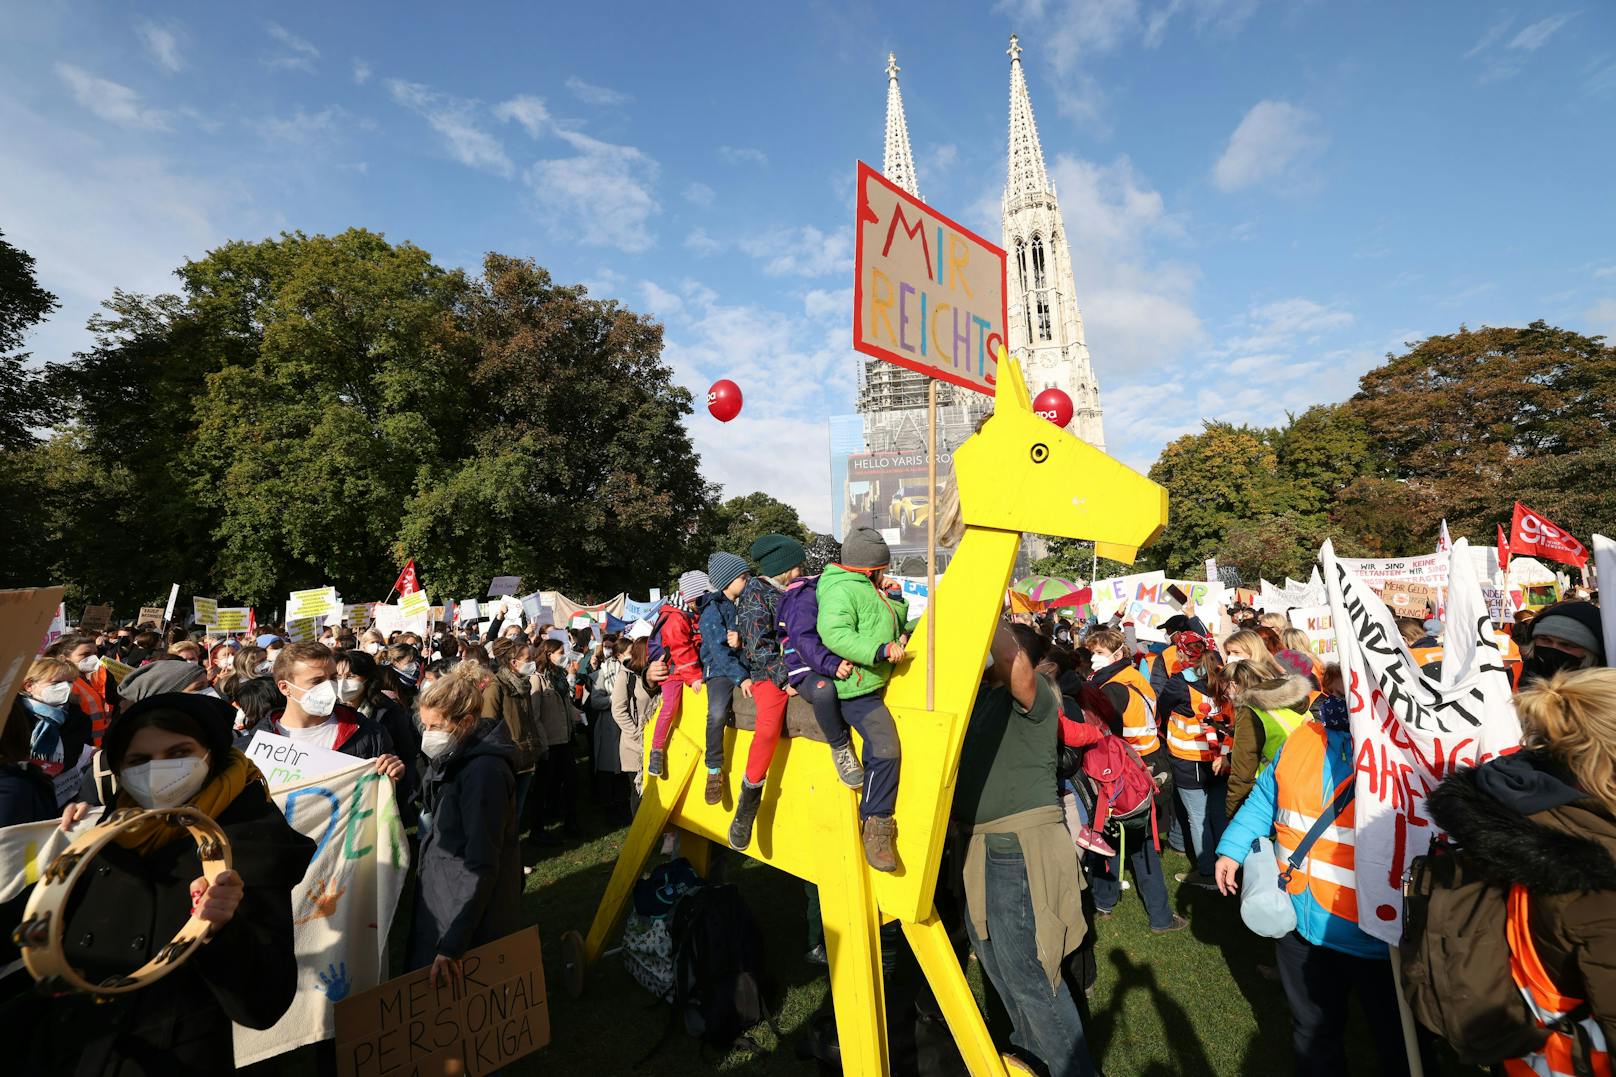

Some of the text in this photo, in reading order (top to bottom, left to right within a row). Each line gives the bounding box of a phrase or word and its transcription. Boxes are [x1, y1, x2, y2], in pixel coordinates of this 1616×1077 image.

[882, 201, 974, 301] MIR
[871, 266, 1003, 385] REICHTS
[854, 457, 889, 469] HELLO
[892, 455, 923, 467] YARIS
[1384, 562, 1405, 570] SIND
[1412, 558, 1436, 568] KEINE
[1409, 567, 1424, 575] WIR
[1428, 564, 1447, 574] SIND
[1384, 581, 1405, 593] MEHR
[1407, 583, 1428, 595] GELD
[253, 742, 309, 766] mehr
[380, 956, 489, 1032] MEHR
[353, 971, 544, 1077] PERSONAL
